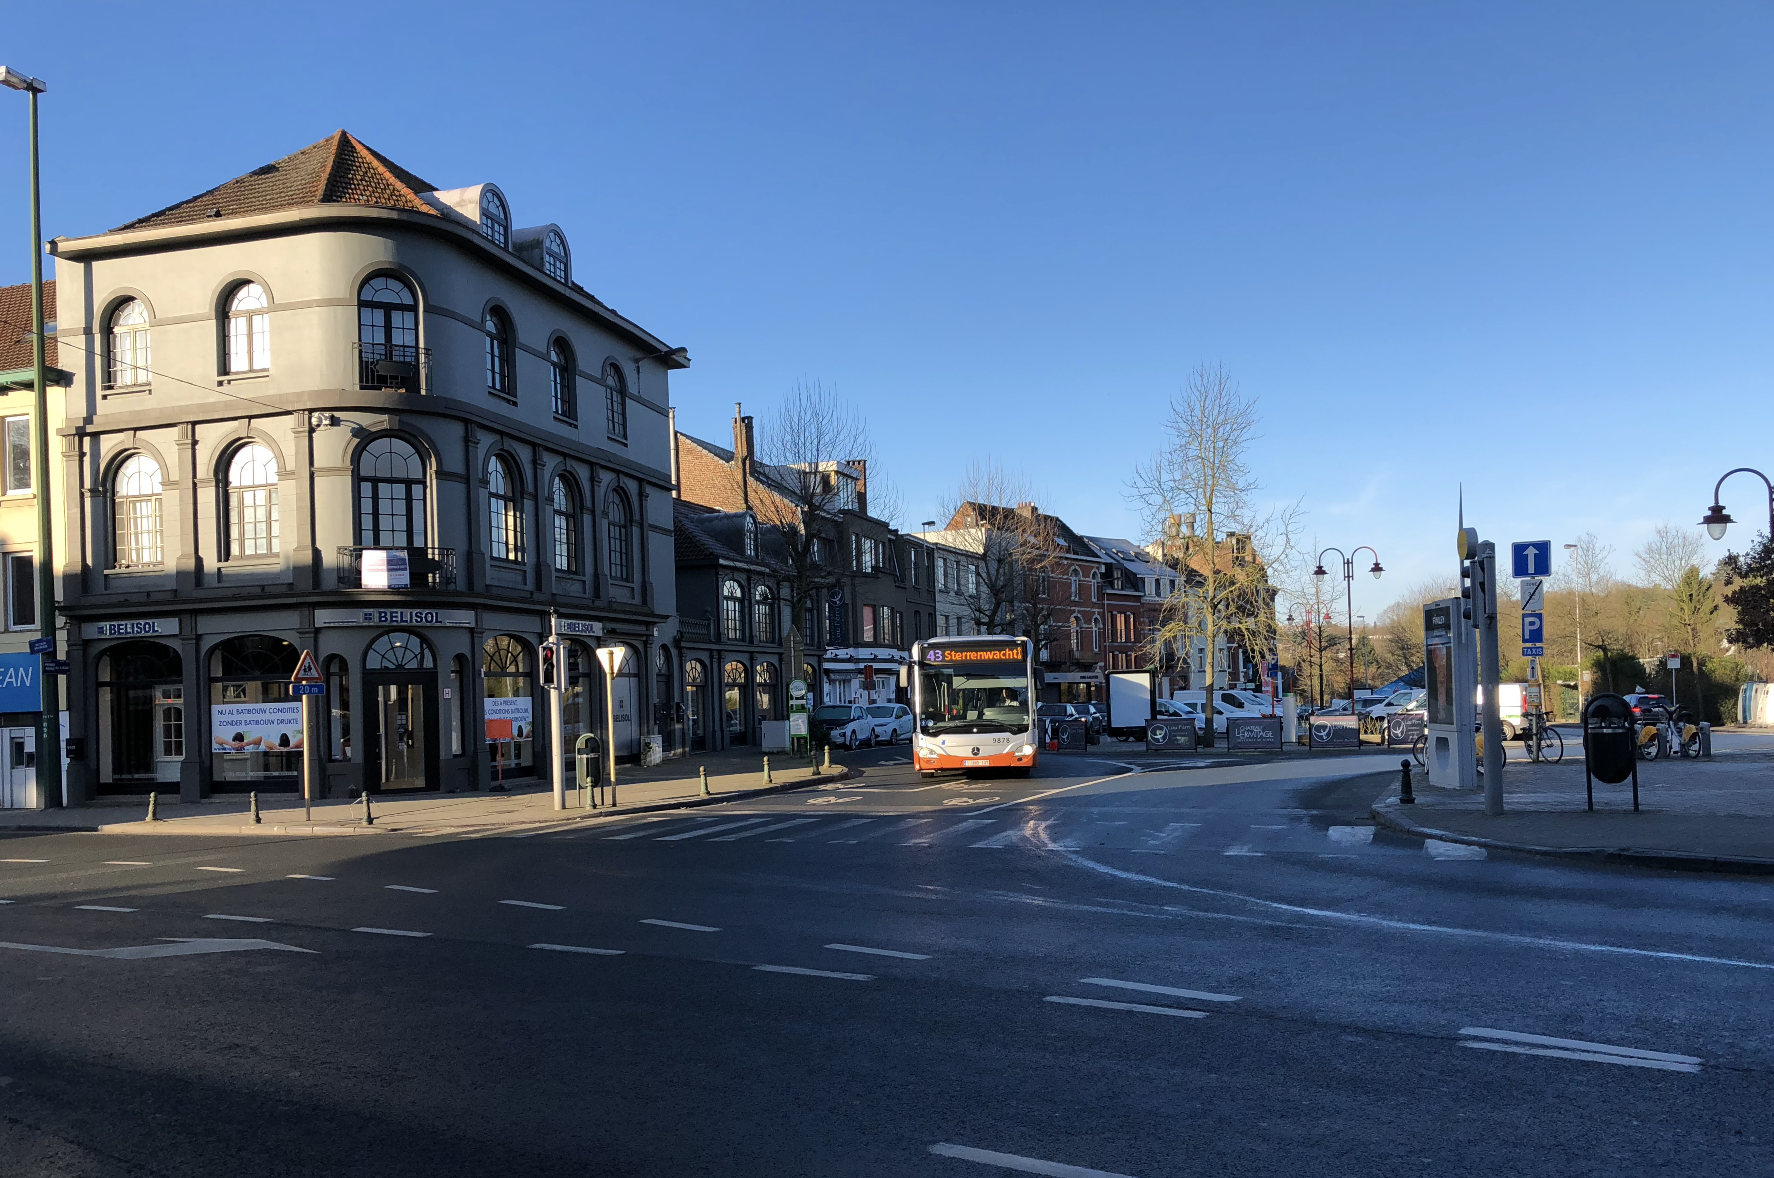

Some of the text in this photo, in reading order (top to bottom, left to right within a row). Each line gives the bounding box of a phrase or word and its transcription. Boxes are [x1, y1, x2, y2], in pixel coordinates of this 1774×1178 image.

[378, 610, 442, 624] BELISOL
[109, 621, 159, 636] BELISOL
[569, 621, 596, 634] BELISOL
[1524, 617, 1540, 640] P
[927, 648, 1018, 661] 43 Sterrenwacht
[299, 686, 310, 694] 20
[228, 708, 235, 716] AL
[218, 717, 299, 727] ZONDER BATIBOUW DRUKTE
